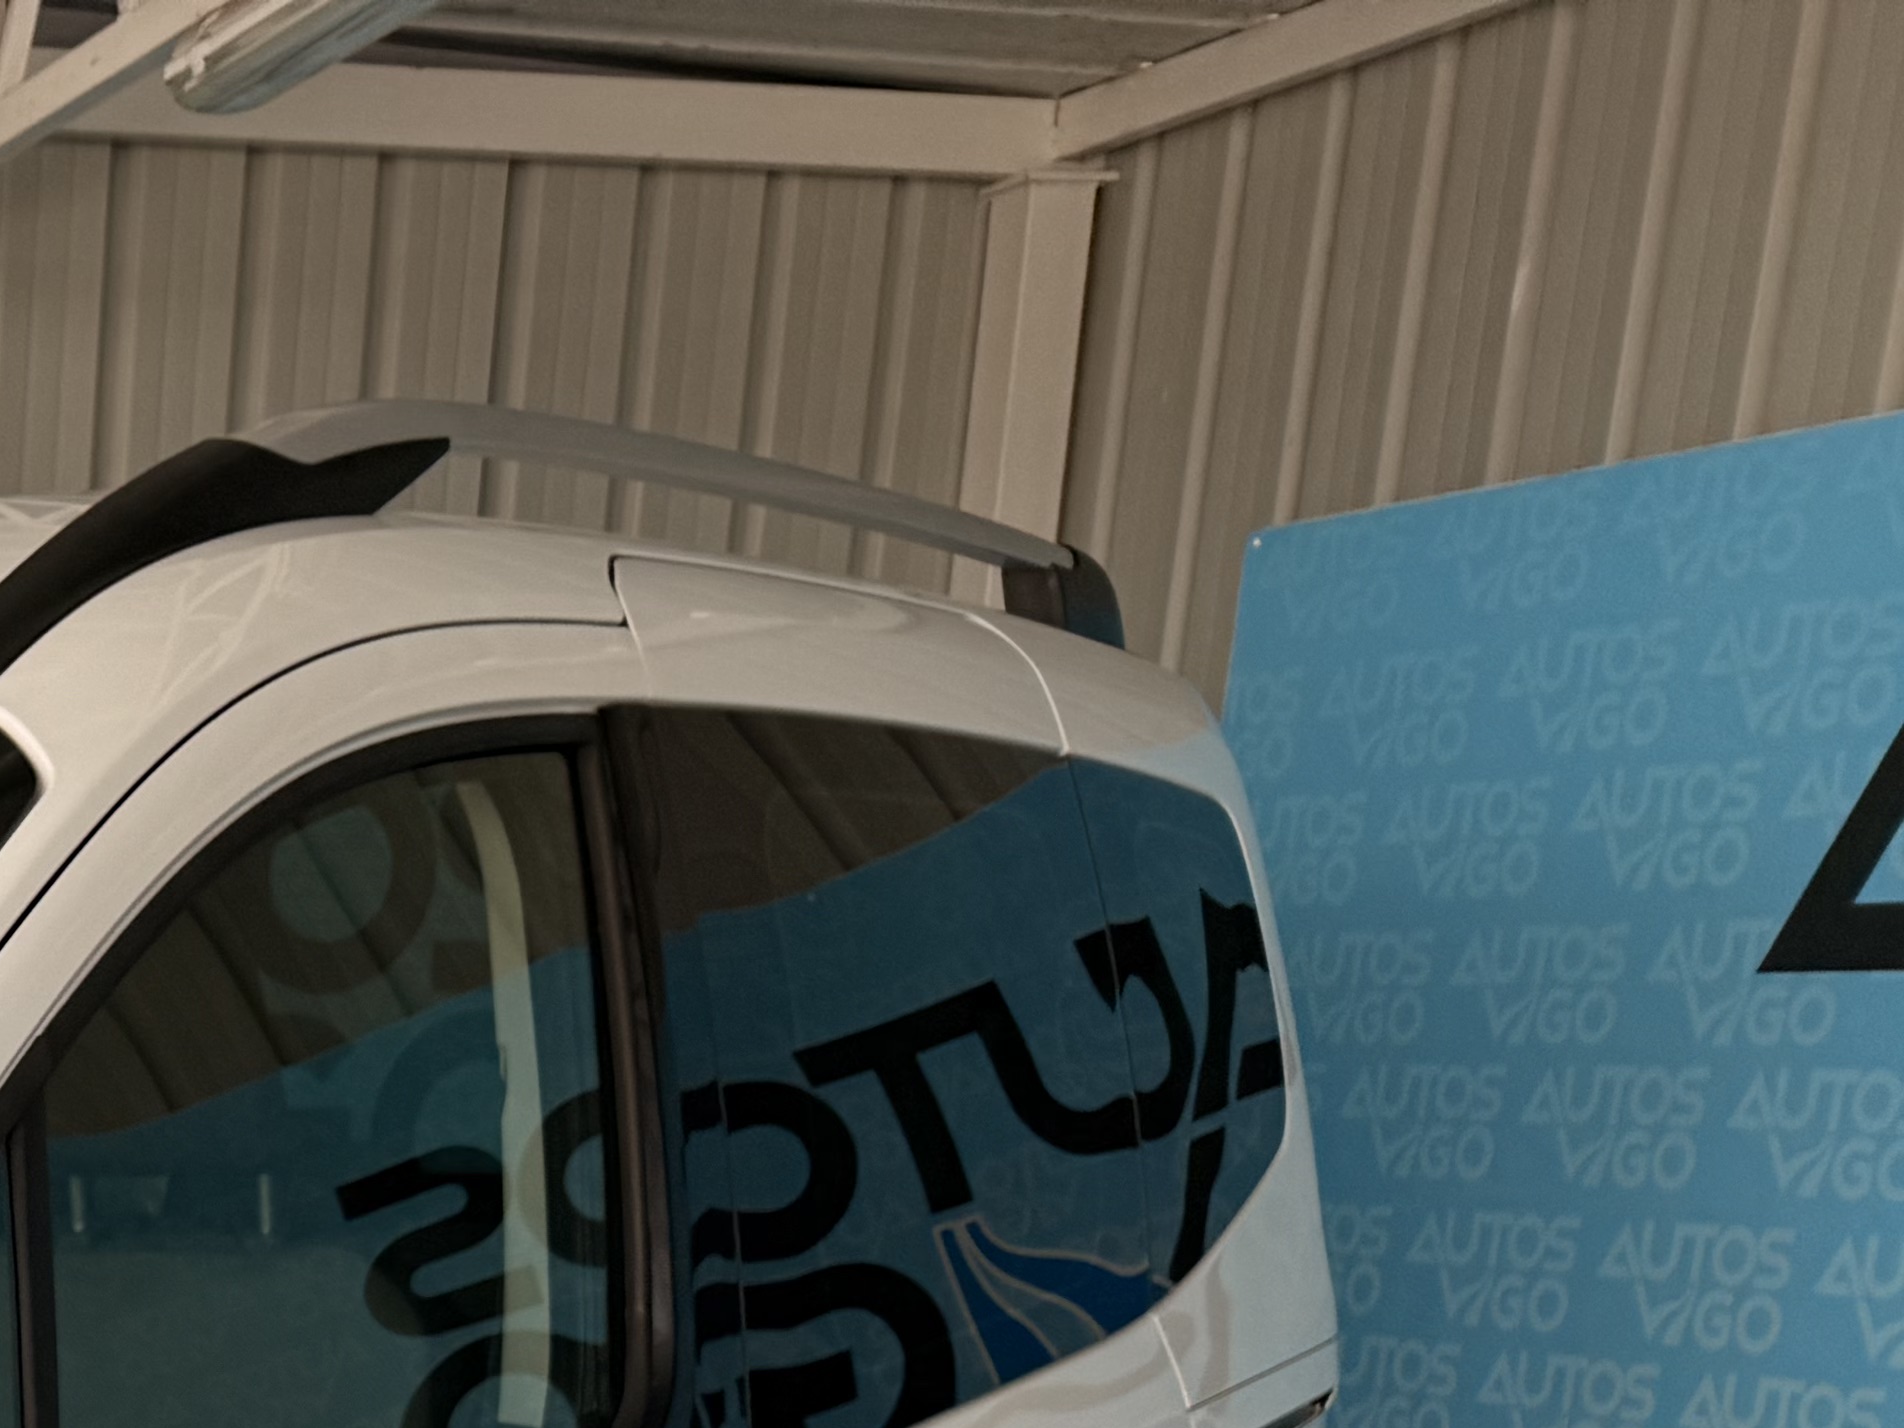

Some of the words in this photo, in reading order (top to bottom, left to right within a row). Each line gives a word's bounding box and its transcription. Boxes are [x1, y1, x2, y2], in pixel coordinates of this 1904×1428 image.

[1318, 644, 1482, 719] AUTOS
[1497, 617, 1683, 699] AUTOS
[1528, 686, 1668, 754] VIGO
[1739, 663, 1898, 737] VIGO
[1380, 775, 1554, 846] AUTOS
[1564, 756, 1766, 836] AUTOS
[1604, 825, 1751, 894] VIGO
[1449, 921, 1632, 986] AUTOS
[1482, 986, 1618, 1047] VIGO
[1682, 982, 1837, 1048] VIGO
[1340, 1062, 1508, 1122] AUTOS
[1519, 1064, 1712, 1127] AUTOS
[1725, 1066, 1904, 1131] AUTO
[1556, 1126, 1697, 1191] VIGO
[1405, 1208, 1581, 1274] AUTOS
[1596, 1219, 1796, 1291] AUTOS
[1634, 1283, 1783, 1355] VIGO
[1477, 1350, 1662, 1422] AUTOS
